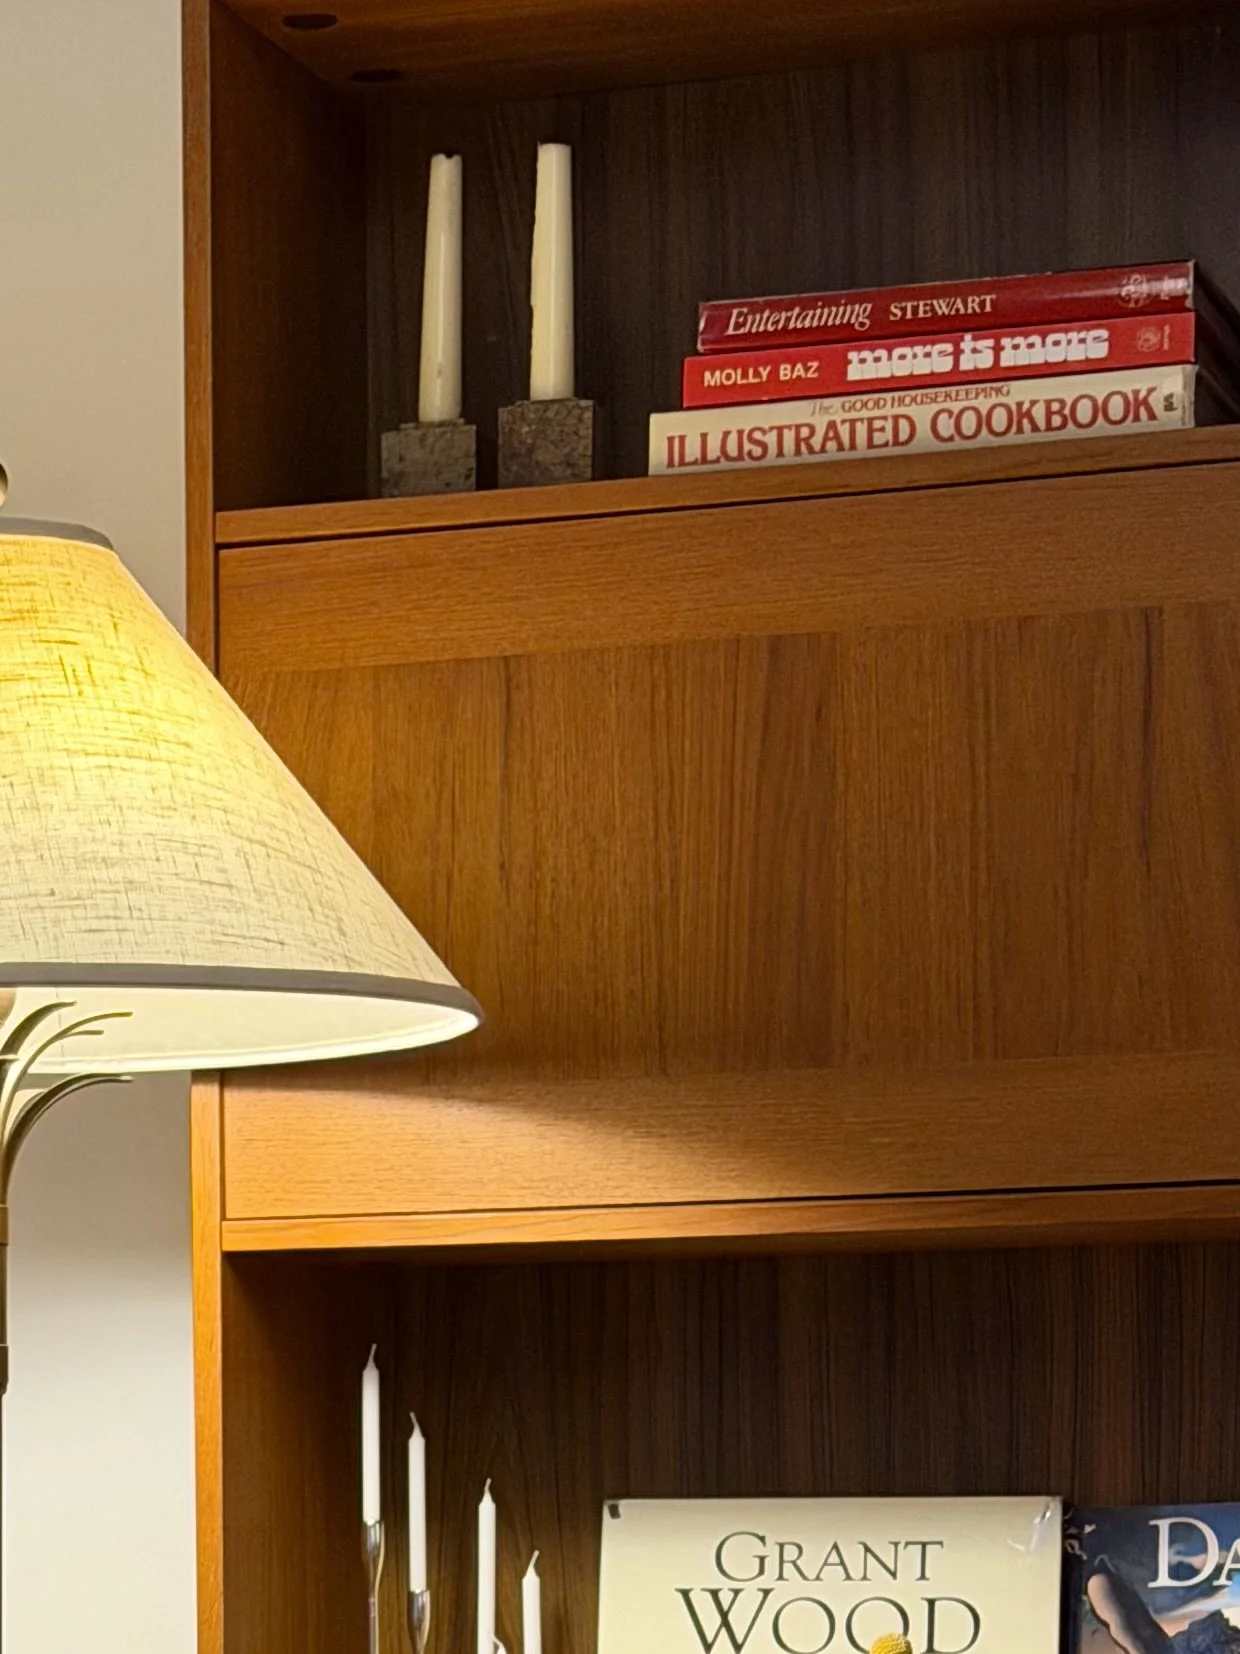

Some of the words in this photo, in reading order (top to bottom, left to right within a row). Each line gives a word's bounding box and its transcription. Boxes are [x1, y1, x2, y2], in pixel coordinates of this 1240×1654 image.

[724, 299, 872, 336] Entertaining
[889, 294, 996, 321] STEWART
[703, 365, 771, 387] MOLLY
[779, 361, 820, 381] BAZ
[846, 343, 954, 381] more
[959, 333, 995, 371] is
[1000, 328, 1109, 368] more
[809, 401, 837, 417] The
[841, 397, 888, 413] GOOD
[891, 384, 1010, 409] HOUSEKEEPING
[666, 413, 917, 468] ILLUSTRATED
[930, 386, 1158, 443] COOKBOOK
[715, 1531, 944, 1583] GRANT
